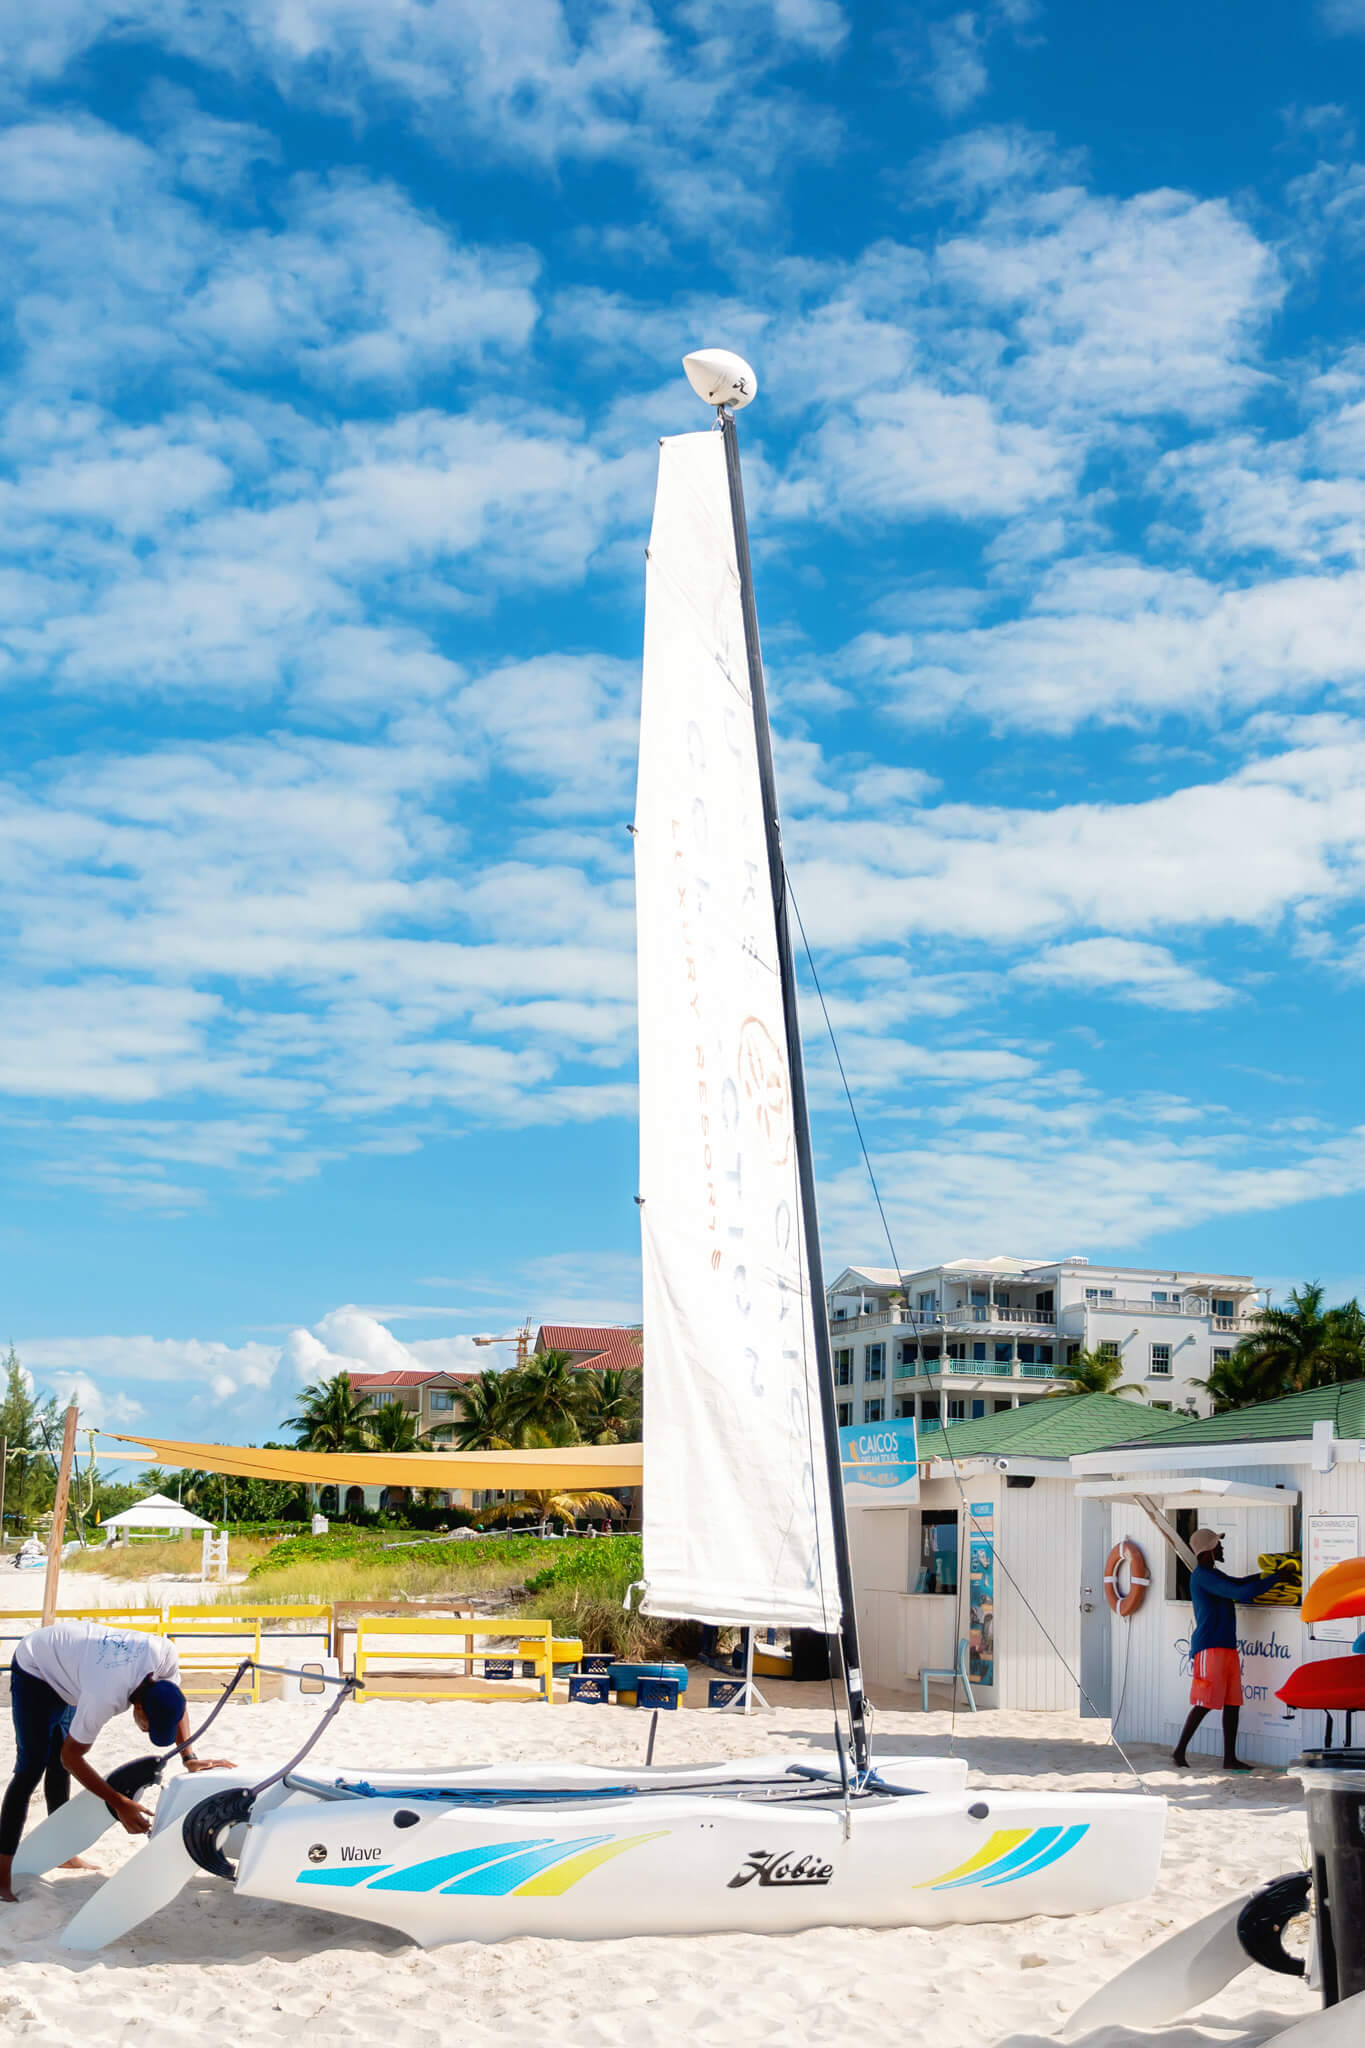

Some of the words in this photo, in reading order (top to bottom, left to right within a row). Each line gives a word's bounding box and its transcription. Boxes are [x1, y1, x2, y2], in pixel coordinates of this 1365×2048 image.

[686, 720, 765, 1397] COLCTION
[695, 1043, 722, 1272] RESORTS
[859, 1431, 898, 1455] CAICOS
[1236, 1631, 1291, 1659] exandra
[340, 1846, 383, 1861] Wave
[726, 1850, 834, 1888] Hobie
